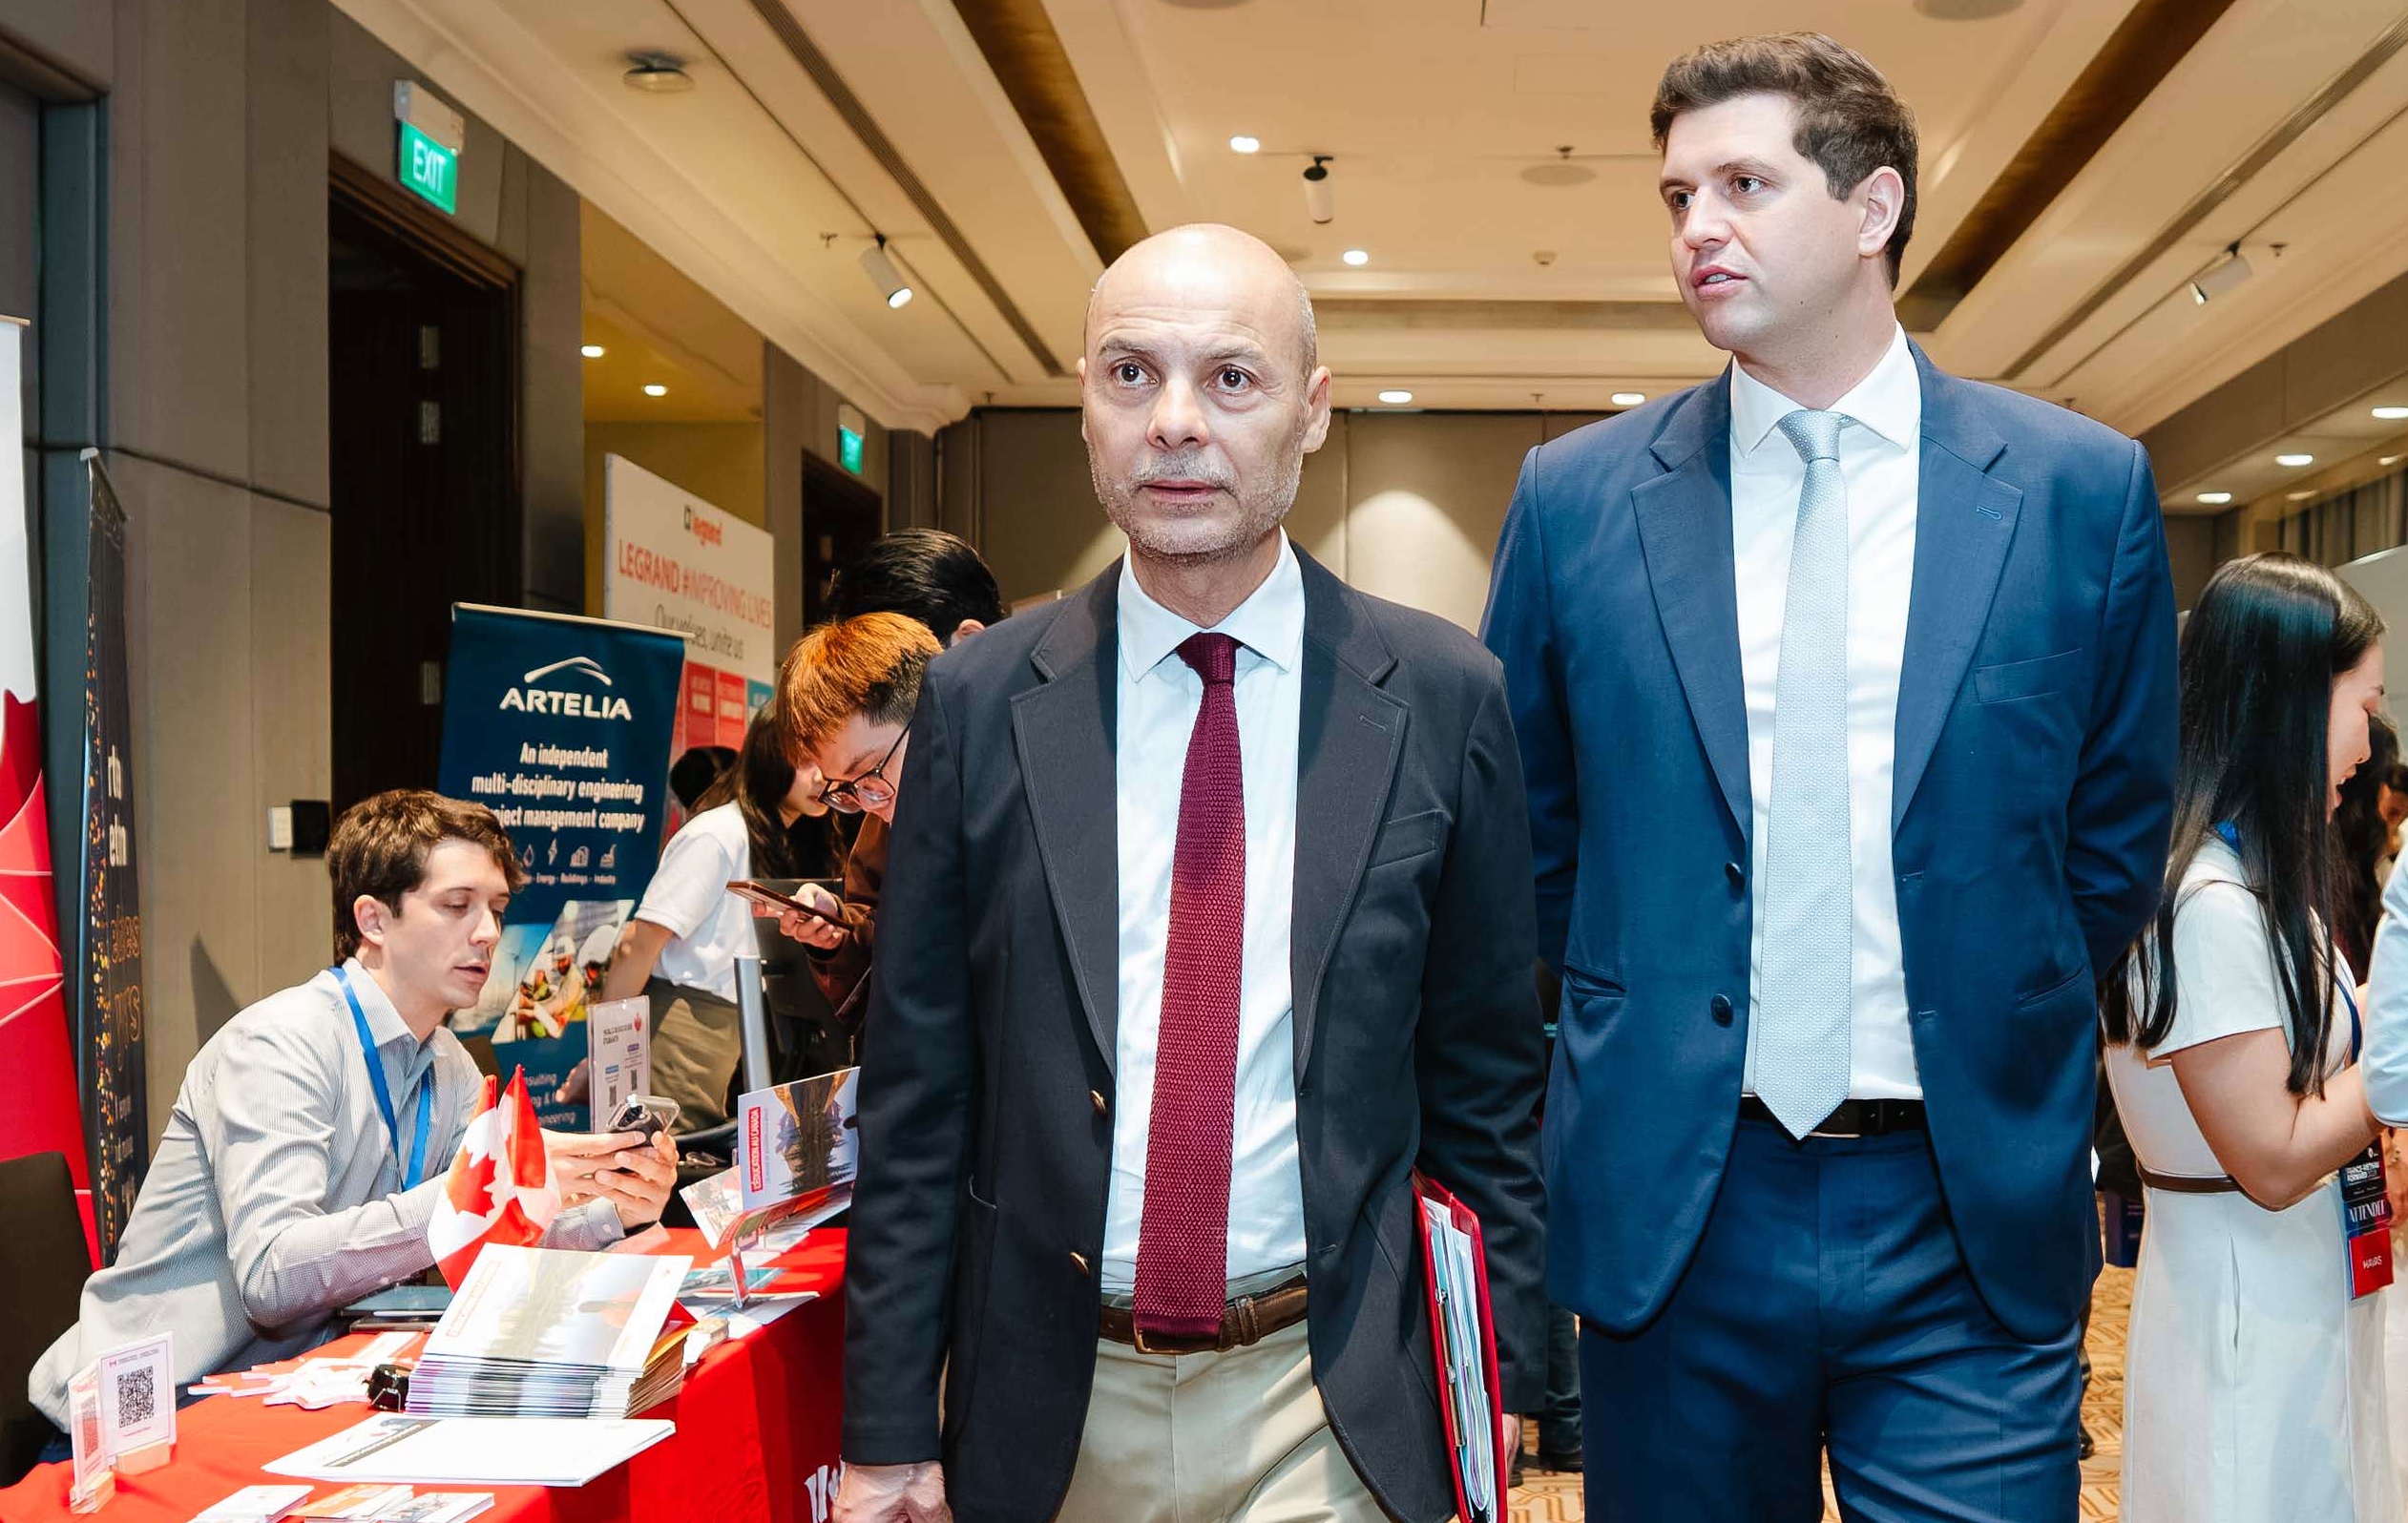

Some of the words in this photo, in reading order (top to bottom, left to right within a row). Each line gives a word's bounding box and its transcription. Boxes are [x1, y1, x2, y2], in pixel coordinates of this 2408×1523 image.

[413, 136, 447, 195] EXIT
[618, 538, 681, 594] LEGRAND
[499, 687, 632, 721] ARTELIA
[520, 741, 536, 764] An
[538, 743, 609, 770] independent
[471, 772, 576, 802] multi-disciplinary
[577, 778, 644, 804] engineering
[524, 808, 597, 832] management
[598, 813, 646, 833] company
[2349, 1199, 2386, 1222] ATTENDEE
